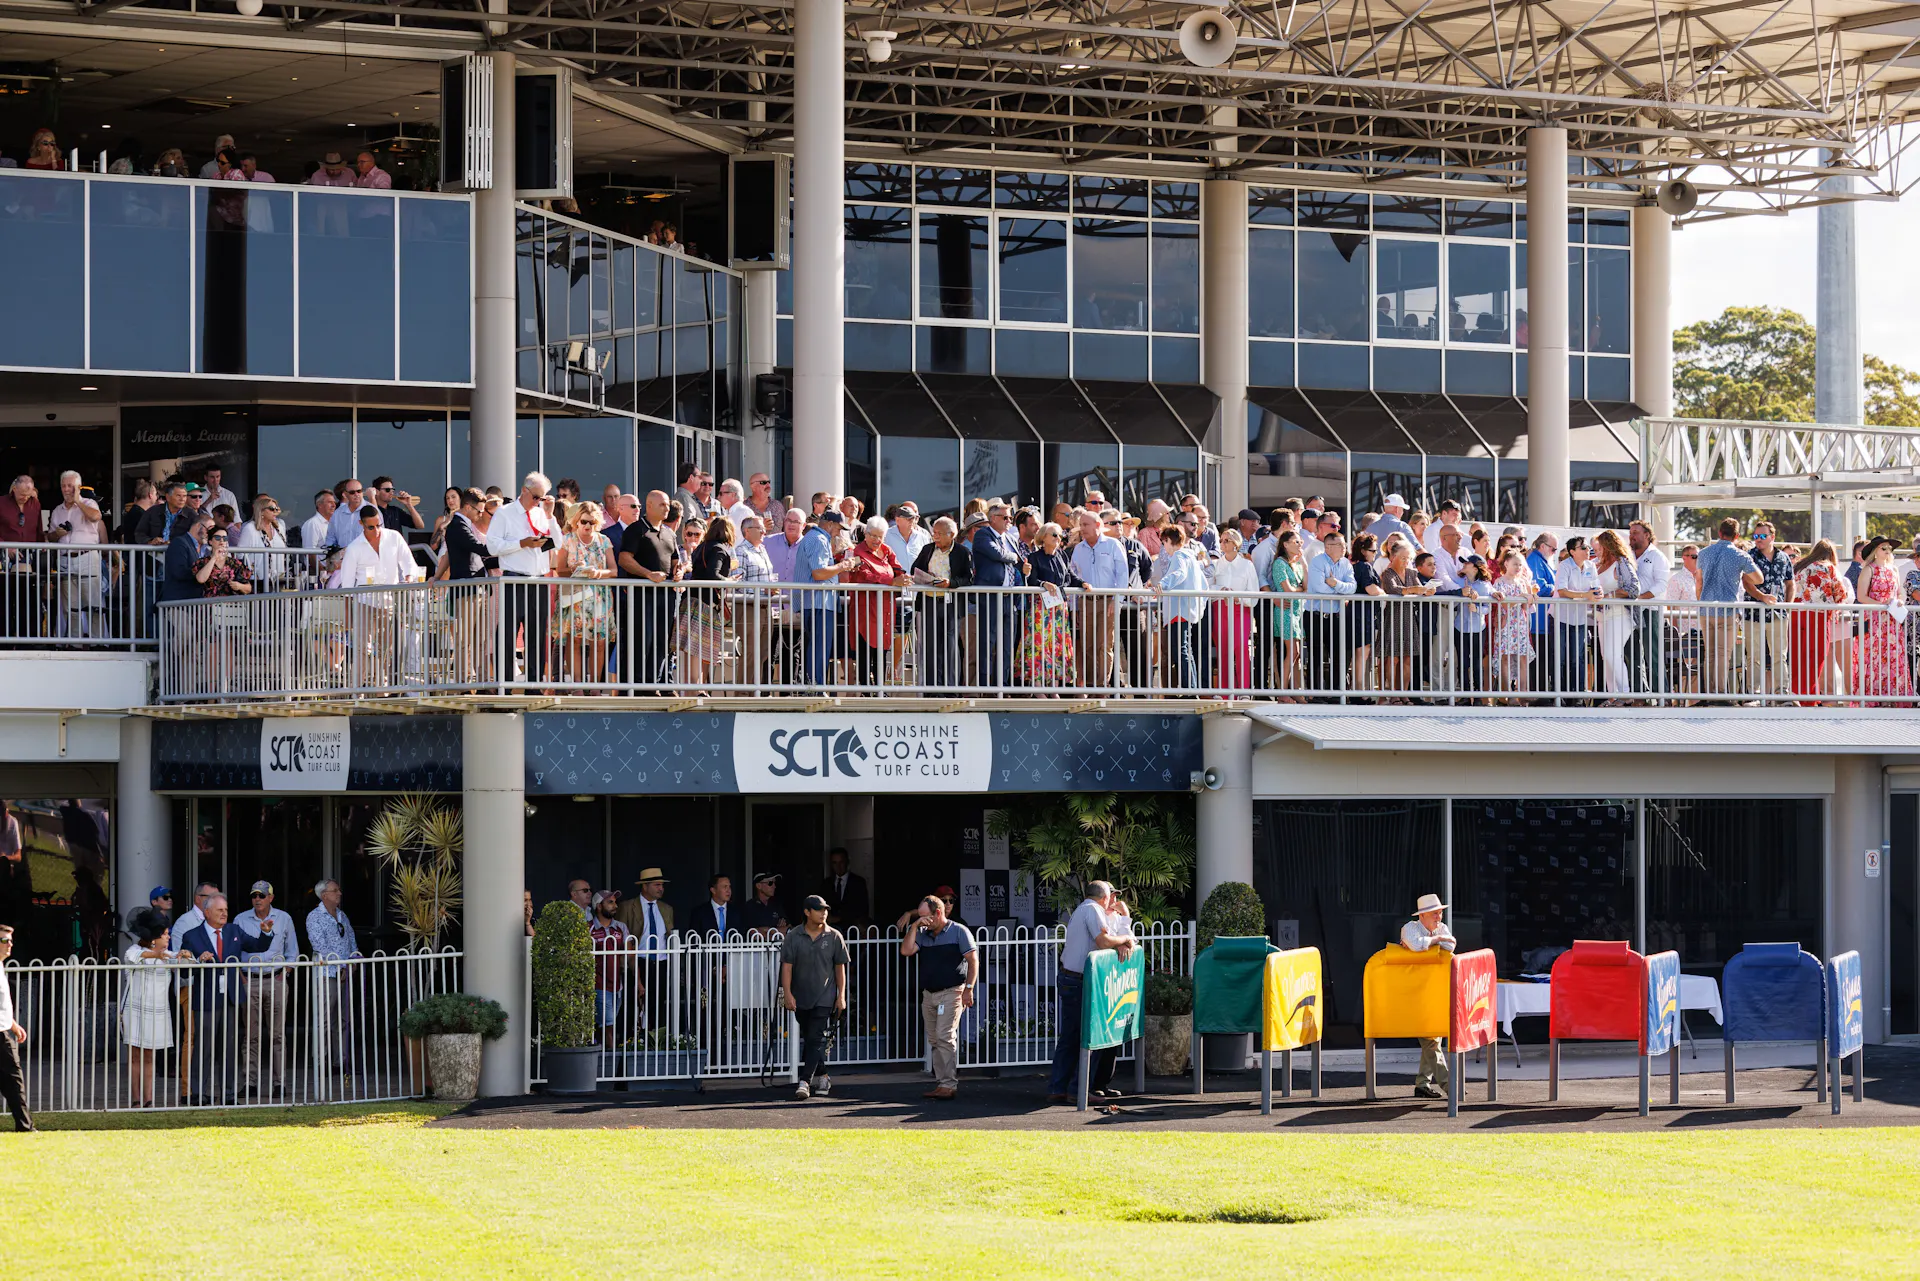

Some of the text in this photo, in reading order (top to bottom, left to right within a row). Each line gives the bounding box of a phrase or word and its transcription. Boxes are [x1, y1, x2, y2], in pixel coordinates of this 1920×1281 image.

[131, 429, 247, 443] Members Lounge
[308, 732, 341, 743] SUNSHINE
[874, 725, 959, 738] SUNSHINE
[308, 744, 341, 759] COAST
[874, 741, 959, 760] COAST
[308, 762, 341, 772] TURF CLUB
[875, 764, 960, 776] TURF CLUB
[1104, 964, 1138, 1014] Winners
